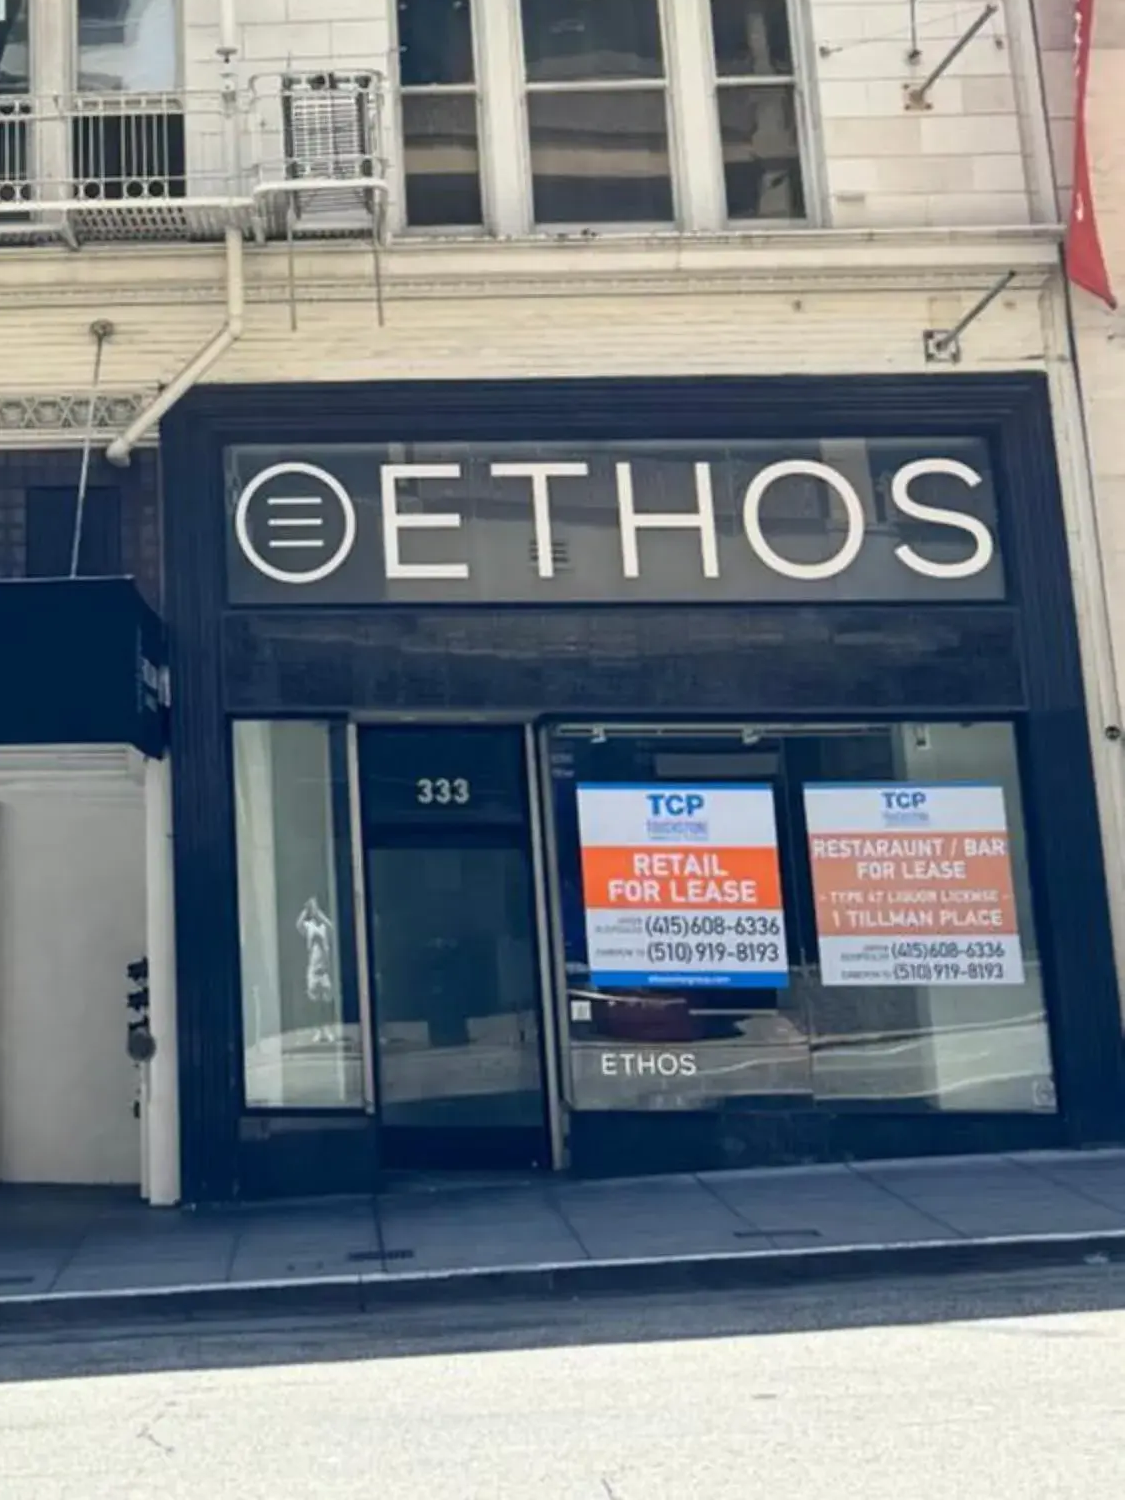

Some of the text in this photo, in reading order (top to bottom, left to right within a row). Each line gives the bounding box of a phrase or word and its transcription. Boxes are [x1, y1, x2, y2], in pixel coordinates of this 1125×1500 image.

[379, 457, 994, 582] ETHOS
[416, 777, 470, 804] 333
[881, 791, 926, 809] TCP
[646, 793, 705, 817] TCP
[811, 838, 943, 859] RESTARAUNT
[963, 837, 1007, 857] BAR
[633, 853, 729, 877] RETAIL
[856, 860, 967, 880] FOR LEASE
[607, 880, 758, 904] FOR LEASE
[830, 890, 864, 905] TYPE
[940, 889, 1000, 904] LICENSE
[831, 909, 1003, 928] 1 TILLMAN PLACE
[601, 1052, 698, 1077] ETHOS
